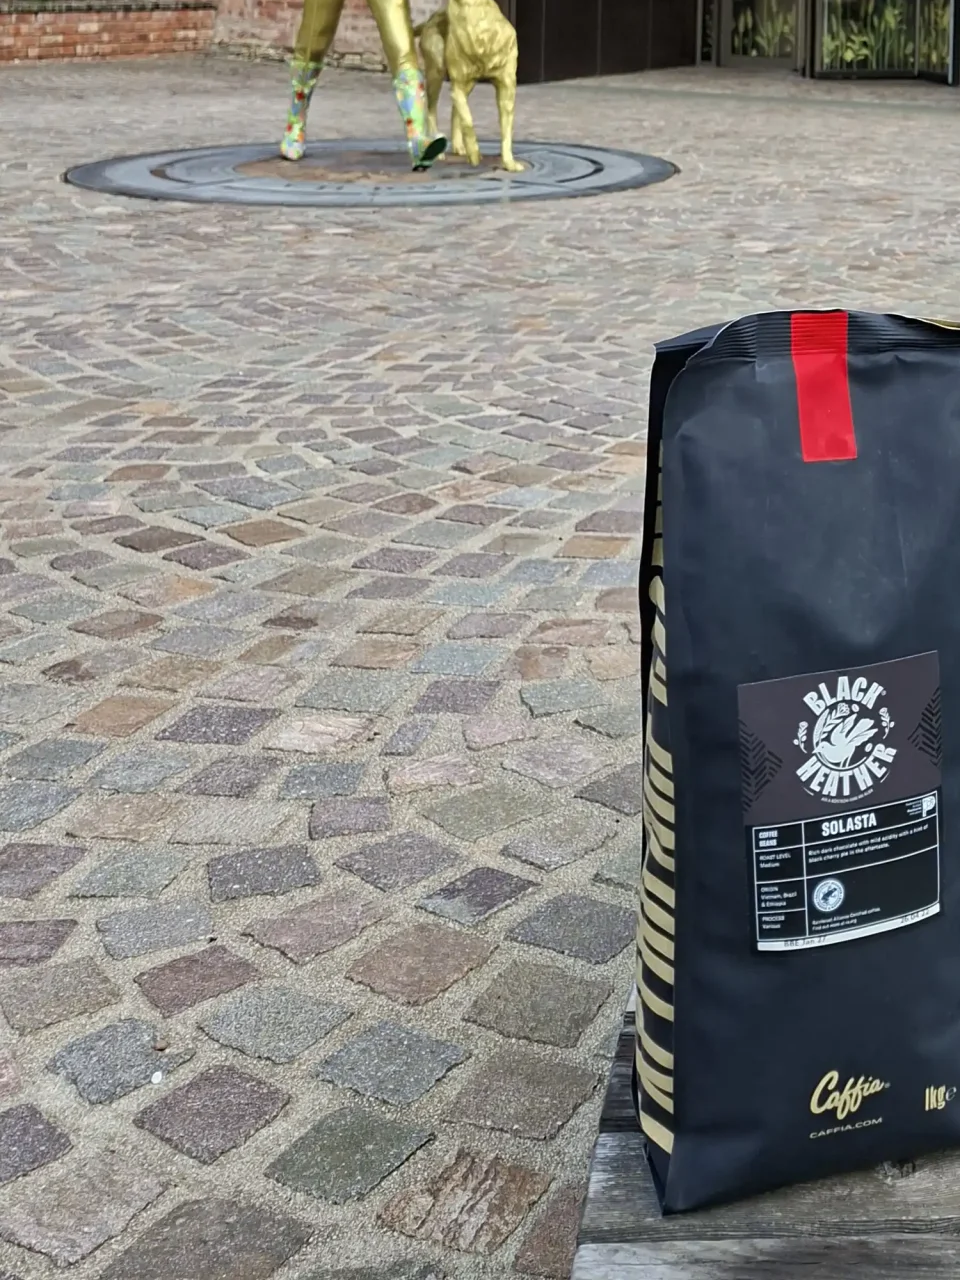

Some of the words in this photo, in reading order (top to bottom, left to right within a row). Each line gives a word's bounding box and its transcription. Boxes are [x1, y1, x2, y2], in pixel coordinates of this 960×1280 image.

[803, 676, 884, 716] BLACK
[796, 743, 897, 797] HEATHER
[758, 830, 778, 839] COFFEE
[821, 812, 877, 837] SOLASTA
[810, 1070, 885, 1120] Caffia
[809, 1117, 883, 1139] CAFFIA.COM
